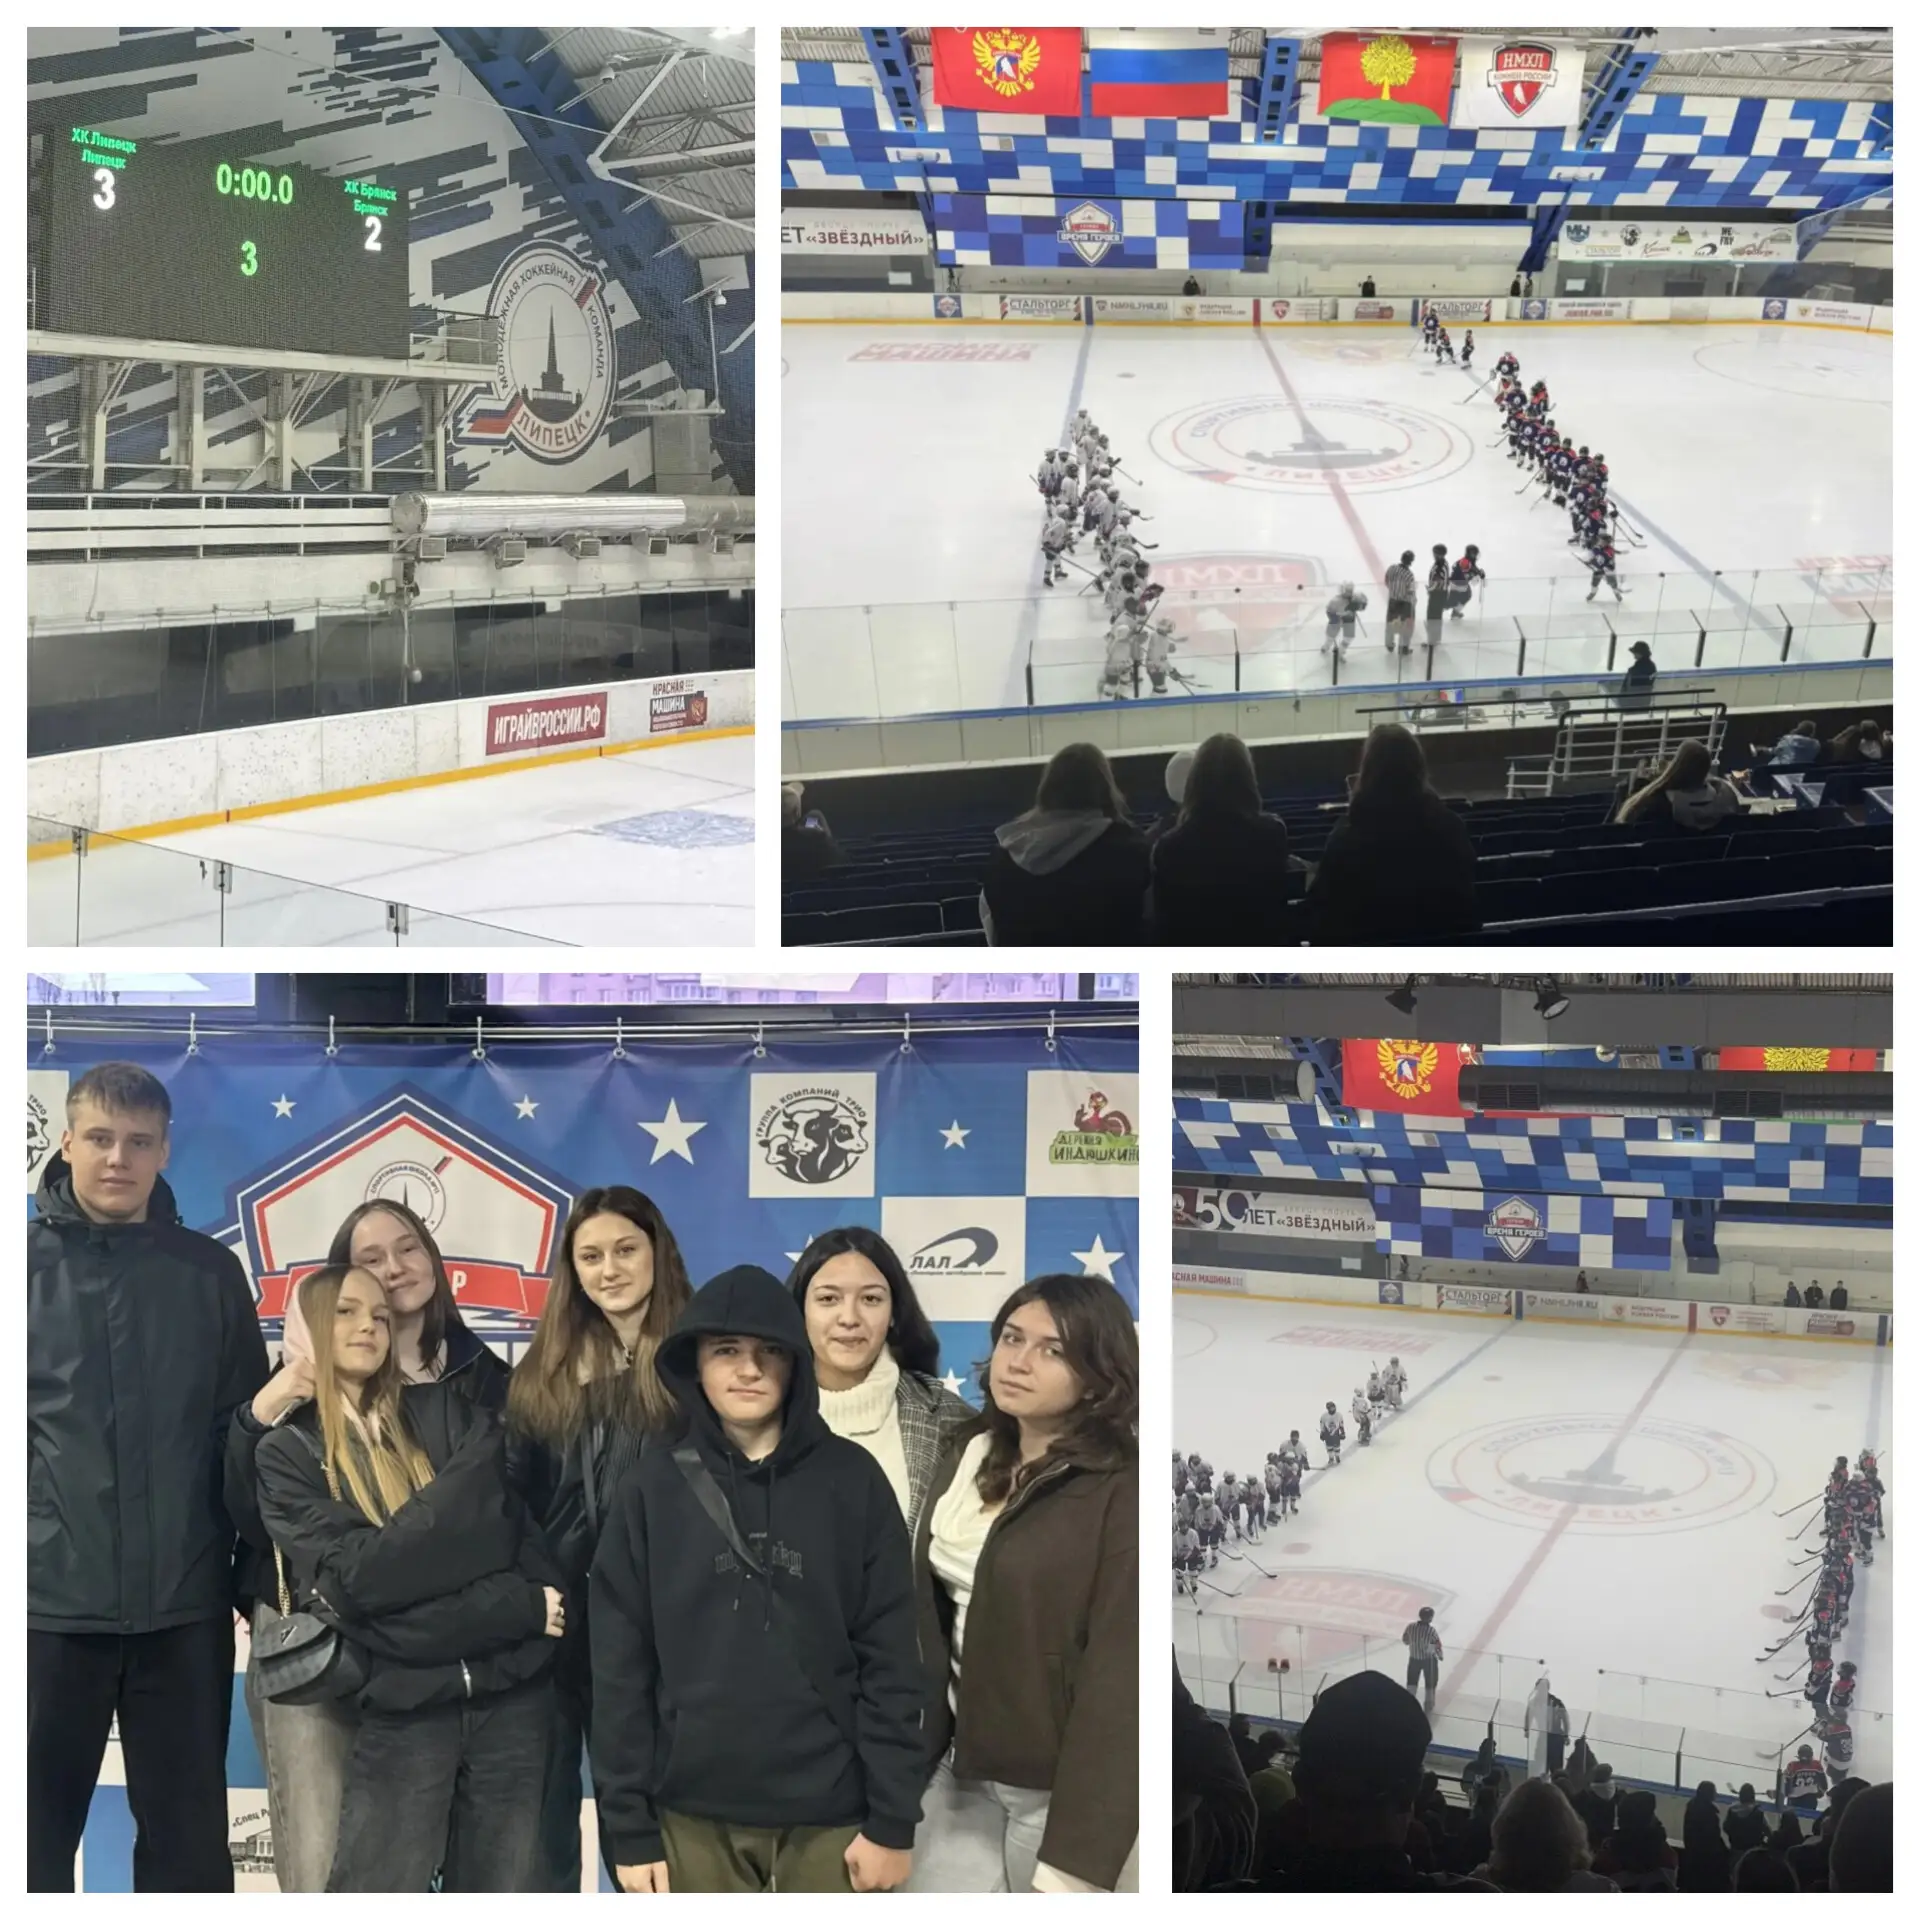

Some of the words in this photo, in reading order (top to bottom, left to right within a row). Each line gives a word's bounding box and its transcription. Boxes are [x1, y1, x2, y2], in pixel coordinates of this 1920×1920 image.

[1503, 53, 1545, 69] НМХЛ
[72, 128, 89, 143] ХК
[91, 132, 136, 153] Липецк
[82, 149, 126, 169] Липецк
[93, 168, 116, 209] 3
[216, 163, 293, 204] 0:00.0
[344, 180, 359, 194] ХК
[361, 183, 397, 201] Брянск
[354, 199, 388, 216] Брянск
[364, 215, 382, 251] 2
[241, 240, 258, 276] 3
[519, 262, 576, 286] ХОККЕЙНАЯ
[1009, 299, 1071, 308] СТАЛЬТОРГ
[587, 305, 605, 379] КОМАНДА
[517, 411, 589, 447] ЛИПЕЦК
[652, 680, 684, 696] КРАСНАЯ
[652, 695, 685, 715] МАШИНА
[494, 704, 600, 745] ИГРАЙВРОССИИ.РФ
[29, 1094, 47, 1115] ТРИО
[756, 1104, 778, 1138] ГРУППА
[779, 1087, 840, 1104] КОМПАНИЙ
[845, 1096, 867, 1118] ТРИО
[1196, 1188, 1250, 1230] 50
[1242, 1208, 1276, 1225] ЛЕТ
[1487, 1226, 1513, 1236] ВРЕМЯ
[1515, 1228, 1545, 1238] ГЕРОЕВ
[909, 1256, 951, 1269] ЛАЛ
[1445, 1289, 1501, 1301] СТАЛЬТОРГ
[1503, 1496, 1662, 1520] ЛИЕЦК
